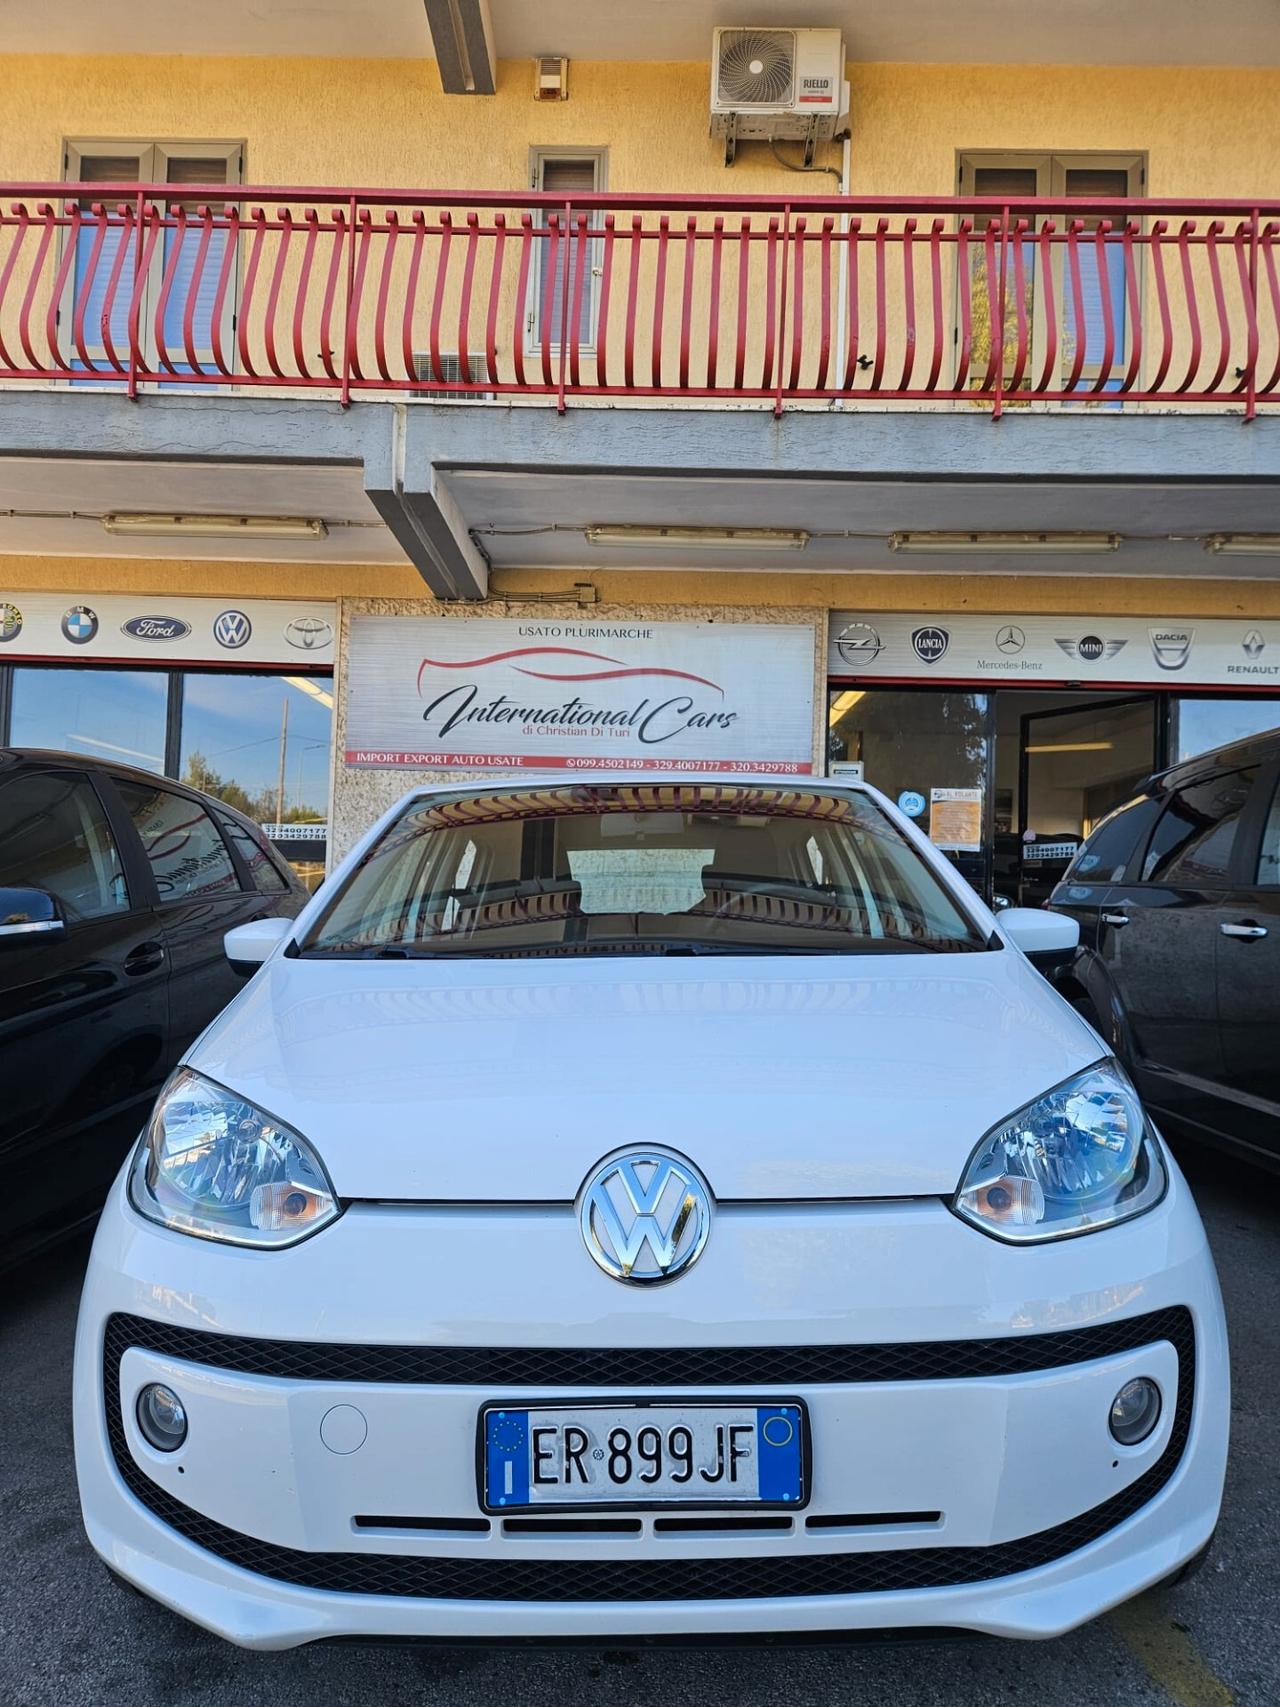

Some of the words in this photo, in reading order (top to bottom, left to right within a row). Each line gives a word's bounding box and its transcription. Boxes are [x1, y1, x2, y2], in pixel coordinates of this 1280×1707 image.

[803, 79, 829, 89] RIELLO
[136, 619, 177, 637] Ford
[518, 626, 562, 637] USATO
[564, 627, 654, 640] PLURIMARCHE
[1155, 633, 1188, 641] DACIA
[918, 638, 943, 649] LANCIA
[1079, 643, 1103, 653] MINI
[976, 659, 1043, 670] Mercedes-Benz
[1227, 665, 1280, 675] RENAULT
[422, 684, 647, 739] International
[637, 696, 740, 744] Cars
[521, 724, 534, 736] di
[535, 724, 588, 737] Christian
[590, 725, 607, 737] Di
[608, 726, 631, 738] Turi
[356, 752, 401, 763] IMPORT
[404, 753, 449, 764] EXPORT
[451, 755, 485, 765] AUTO
[487, 755, 524, 766] USATE
[576, 758, 644, 769] 099.4502149
[652, 760, 721, 771] 329.4007177
[730, 762, 799, 773] 320.3429788
